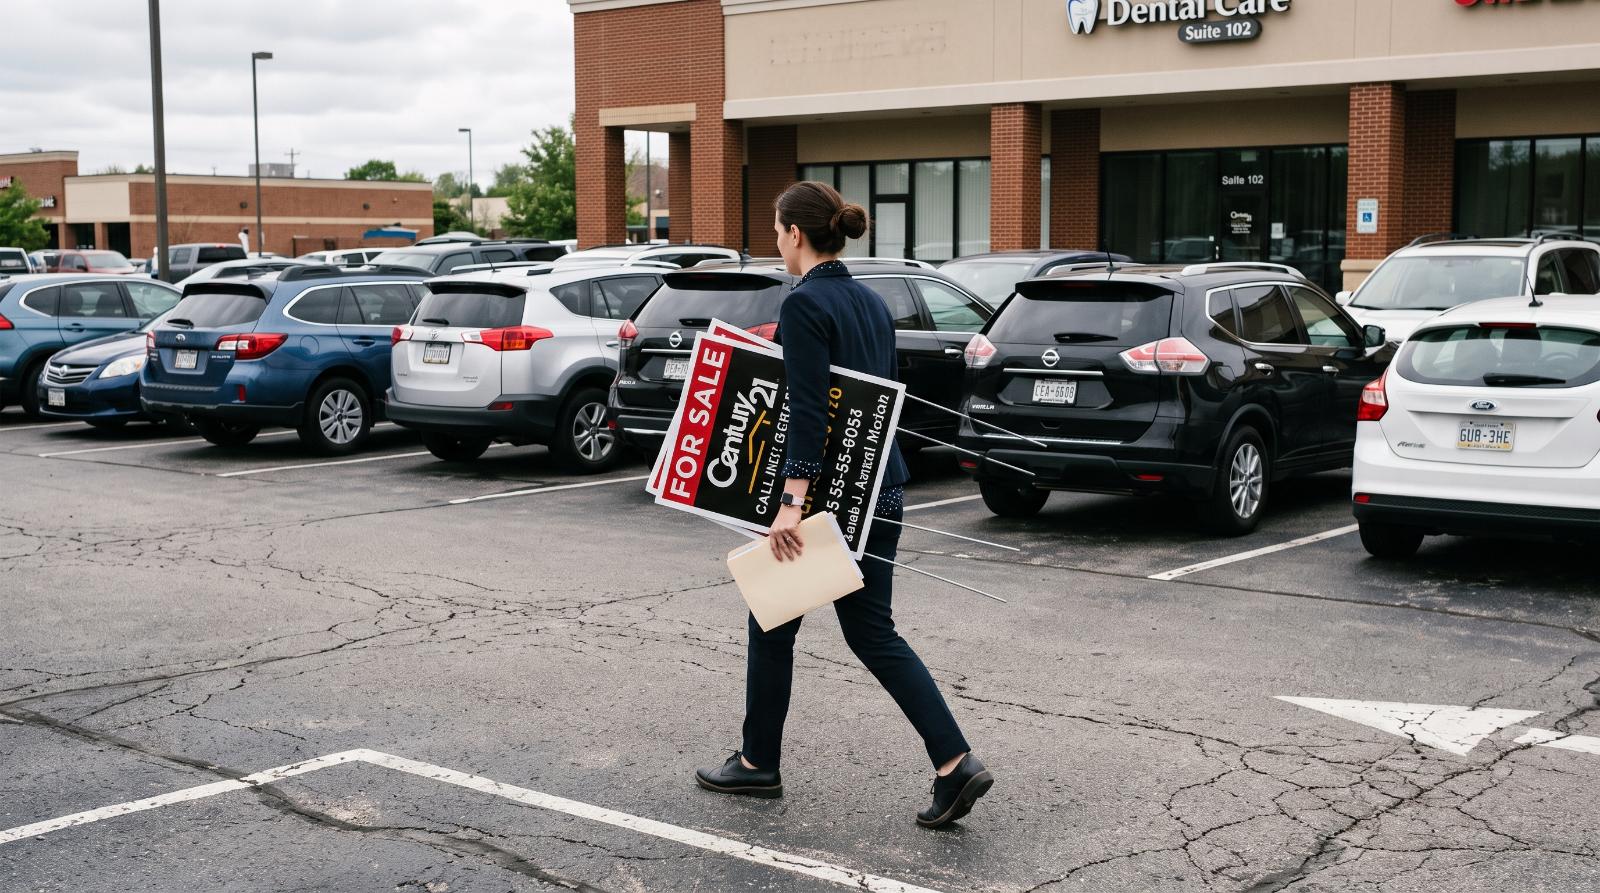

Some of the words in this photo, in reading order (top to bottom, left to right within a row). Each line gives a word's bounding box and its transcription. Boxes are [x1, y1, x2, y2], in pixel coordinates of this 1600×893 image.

[1107, 0, 1206, 26] Dental
[1214, 0, 1289, 17] Care
[1185, 25, 1221, 41] Suite
[1226, 22, 1251, 37] 102
[1247, 174, 1264, 185] 102
[670, 434, 704, 498] FOR
[688, 348, 726, 427] SALE
[707, 390, 756, 488] Century
[749, 377, 779, 409] 21
[755, 479, 775, 515] CALL
